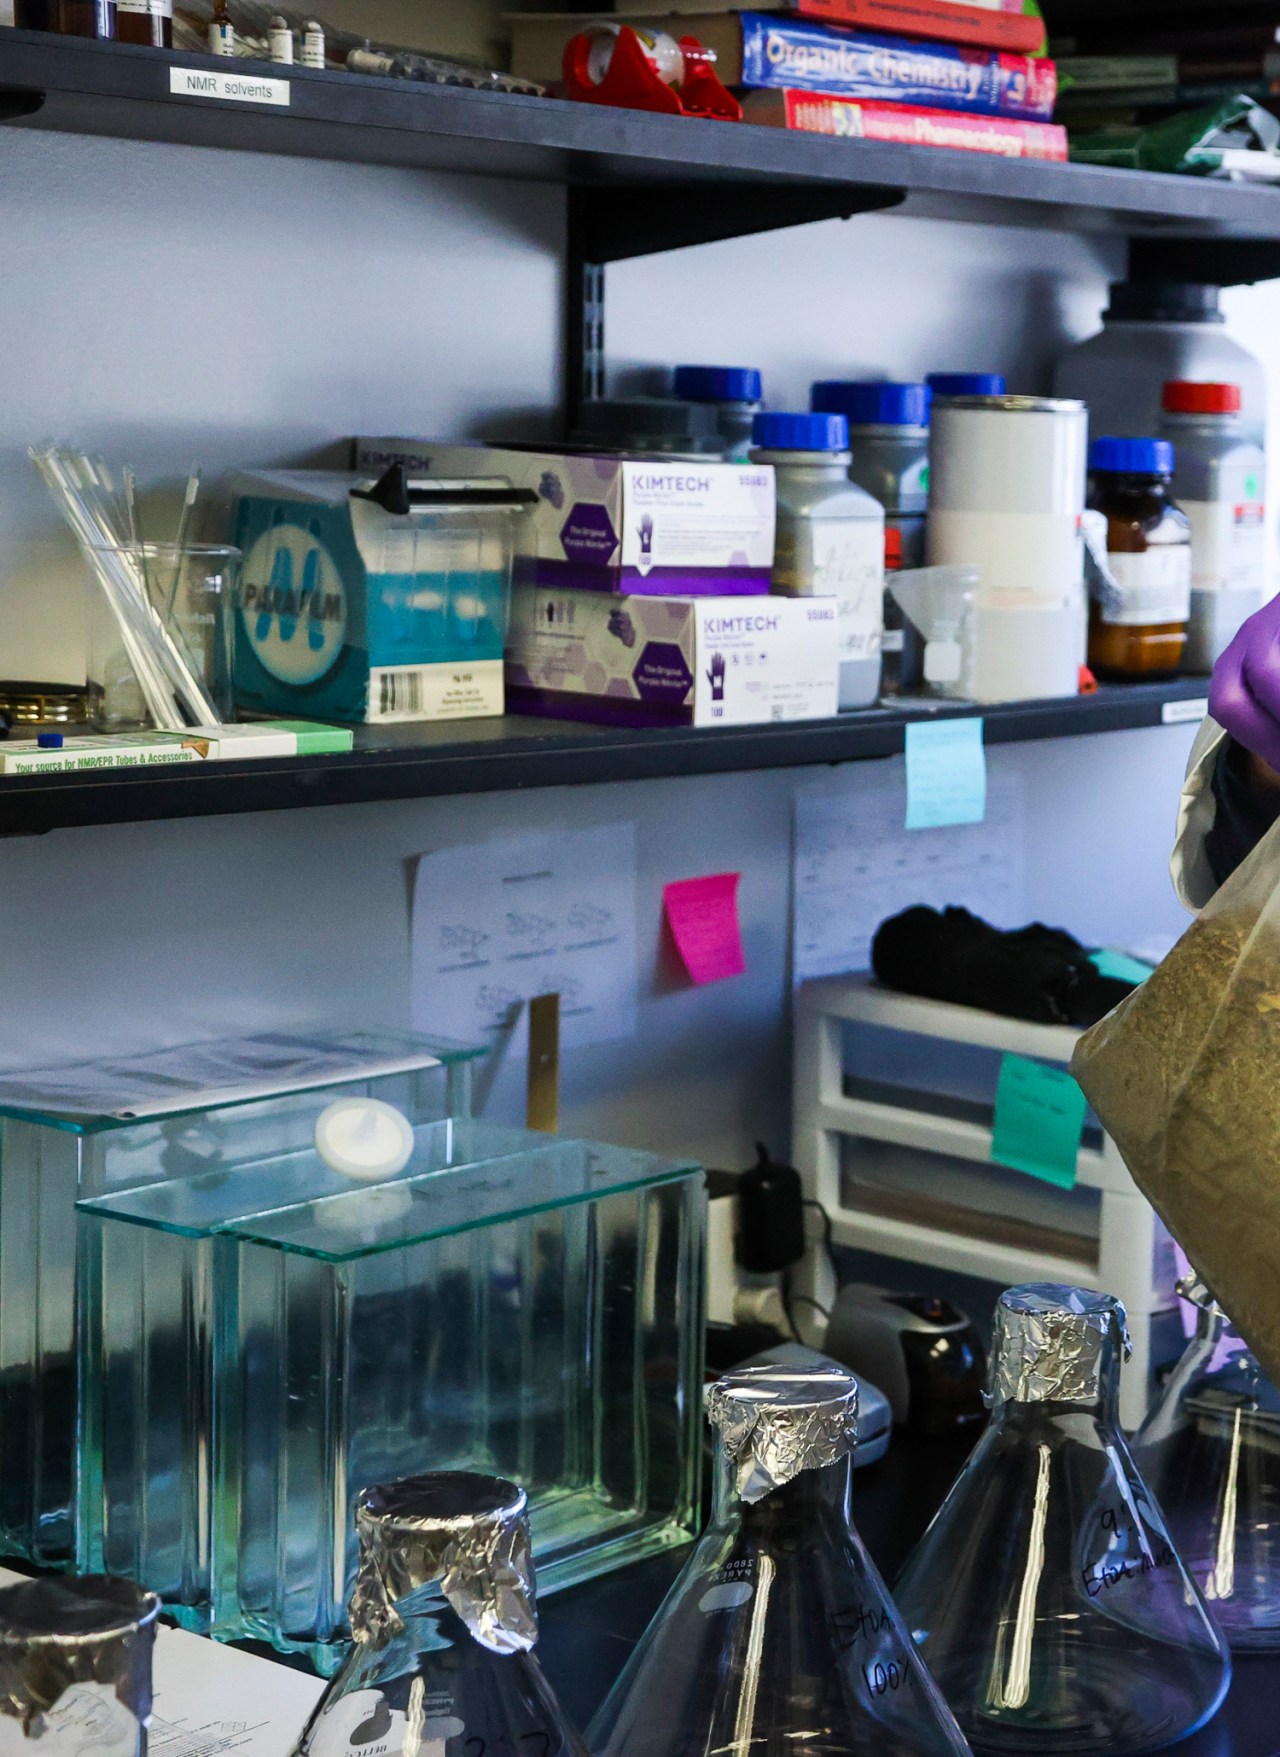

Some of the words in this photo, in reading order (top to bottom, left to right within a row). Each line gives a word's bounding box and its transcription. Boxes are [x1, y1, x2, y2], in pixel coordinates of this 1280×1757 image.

[767, 35, 855, 75] Organic
[869, 48, 982, 99] Chemistry
[187, 75, 217, 92] NMR
[224, 81, 273, 98] solvents
[632, 474, 710, 491] KIMTECH
[704, 615, 777, 633] KIMTECH
[16, 762, 33, 774] Your
[35, 761, 62, 772] source
[64, 760, 75, 771] for
[77, 756, 113, 769] NMR/EPR
[115, 754, 138, 766] Tubes
[139, 754, 146, 763] &
[148, 752, 193, 763] Accessories
